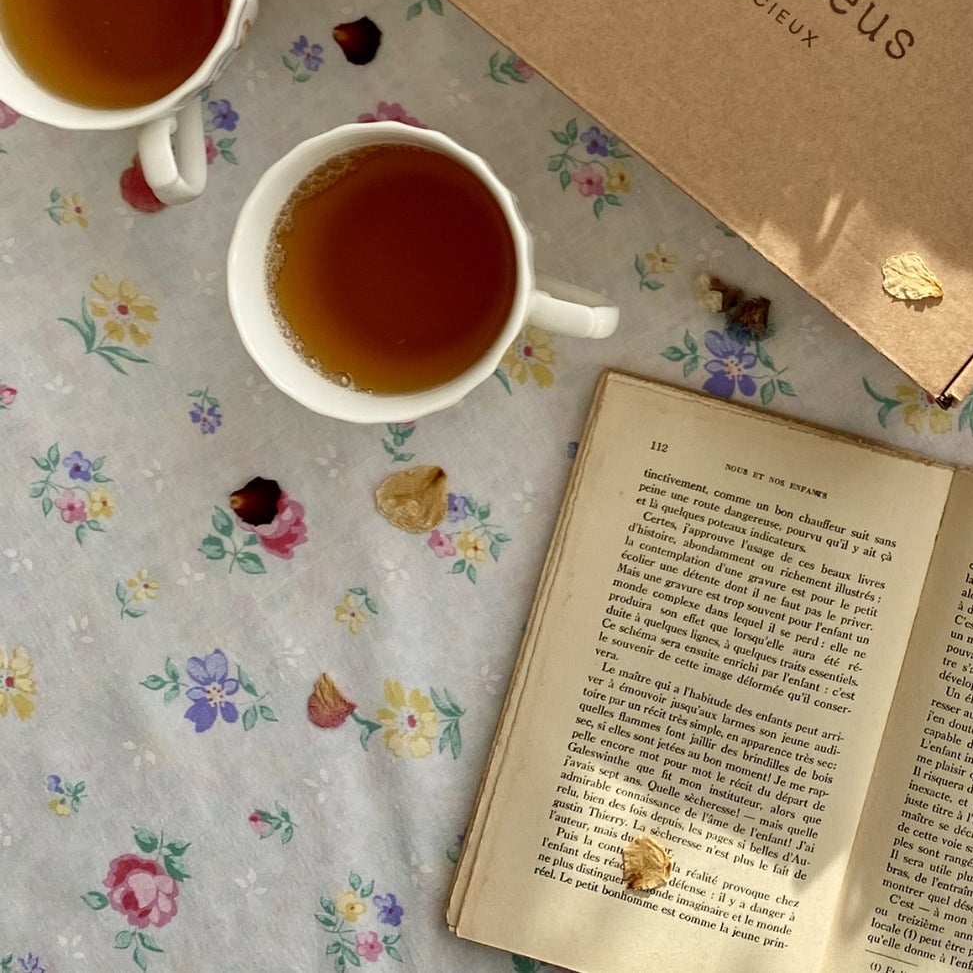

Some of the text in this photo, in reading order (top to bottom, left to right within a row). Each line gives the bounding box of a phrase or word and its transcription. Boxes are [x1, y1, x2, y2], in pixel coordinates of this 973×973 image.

[650, 440, 669, 453] 112
[724, 463, 748, 476] NOUS
[752, 471, 765, 480] ET
[768, 475, 785, 487] NOS
[635, 497, 806, 553] et là quelques poteaux indicateurs.
[638, 483, 892, 562] peine une route dangereuse, pourvu qu'il y ait çà
[643, 468, 897, 548] tinctivement, comme un bon chauffeur suit sans
[642, 511, 886, 589] Certes, j'approuve l'usage de ces beaux livres
[620, 549, 873, 631] écolier une détente dont il ne faut pas le priver.
[957, 600, 964, 611] à
[595, 647, 619, 661] vera.
[607, 592, 863, 672] produira son effet que lorsqu'elle aura été ré-
[601, 661, 844, 742] Le maître qui a l'habitude des enfants peut arri-
[578, 702, 833, 784] quelles flammes font jaillir des brindilles de bois
[567, 741, 822, 825] Galeswinthe que fit mon instituteur, alors que
[908, 779, 953, 803] inexacte,
[957, 798, 968, 807] et
[892, 836, 914, 850] ples
[917, 845, 940, 859] sont
[900, 809, 934, 827] maître
[938, 822, 950, 831] se
[533, 866, 788, 949] réel. Le petit bonhomme est comme la jeune prin-
[881, 878, 925, 898] montrer
[927, 893, 951, 905] quel
